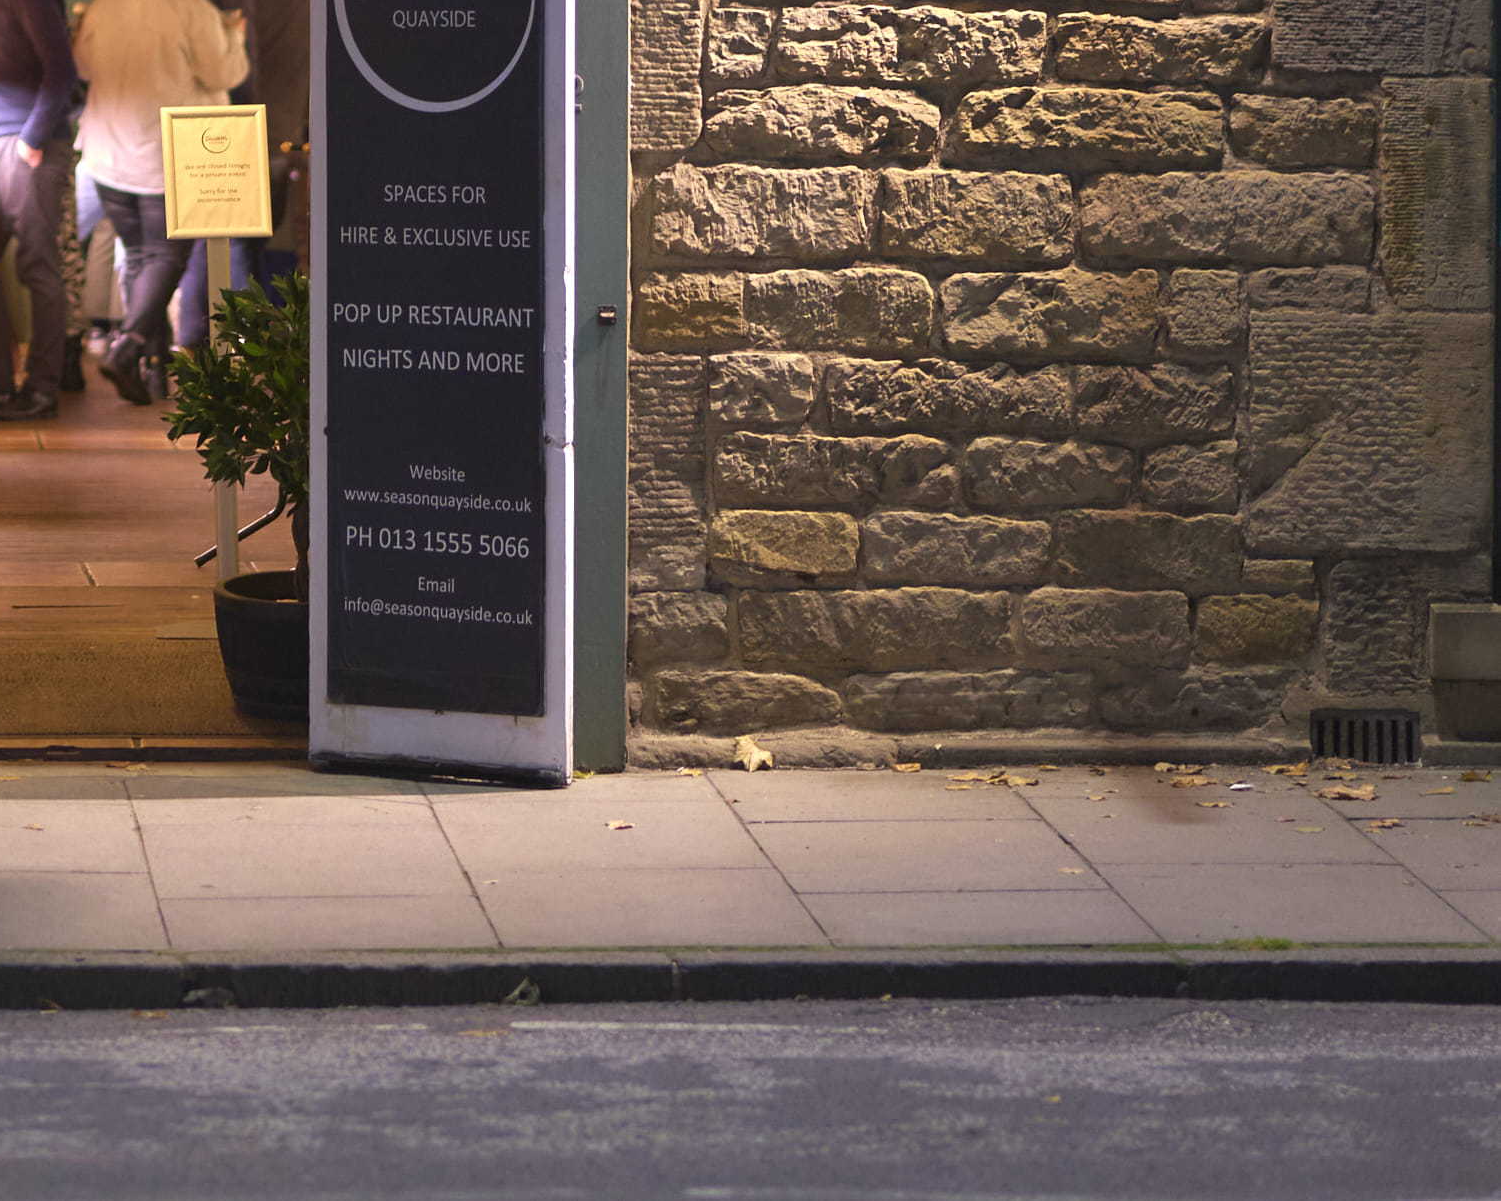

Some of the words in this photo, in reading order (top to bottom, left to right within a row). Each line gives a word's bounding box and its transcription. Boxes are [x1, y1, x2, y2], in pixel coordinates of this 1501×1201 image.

[392, 9, 476, 29] QUAYSIDE
[384, 184, 447, 204] SPACES
[452, 185, 486, 204] FOR
[340, 226, 379, 245] HIRE
[383, 226, 398, 245] &
[403, 227, 493, 248] EXCLUSIVE
[498, 230, 531, 248] USE
[333, 303, 371, 323] POP
[377, 304, 403, 324] UP
[408, 305, 535, 328] RESTAURANT
[343, 348, 413, 369] NIGHTS
[417, 350, 460, 371] AND
[466, 351, 525, 374] MORE
[409, 464, 466, 483] Website
[343, 489, 532, 513] www.seasonquayside.co.uk
[346, 525, 372, 547] PH
[379, 527, 416, 551] 013
[423, 530, 473, 555] 1555
[479, 534, 530, 559] 5066
[418, 576, 455, 594] Email
[344, 596, 533, 626] info@seasonquayside.co.uk
